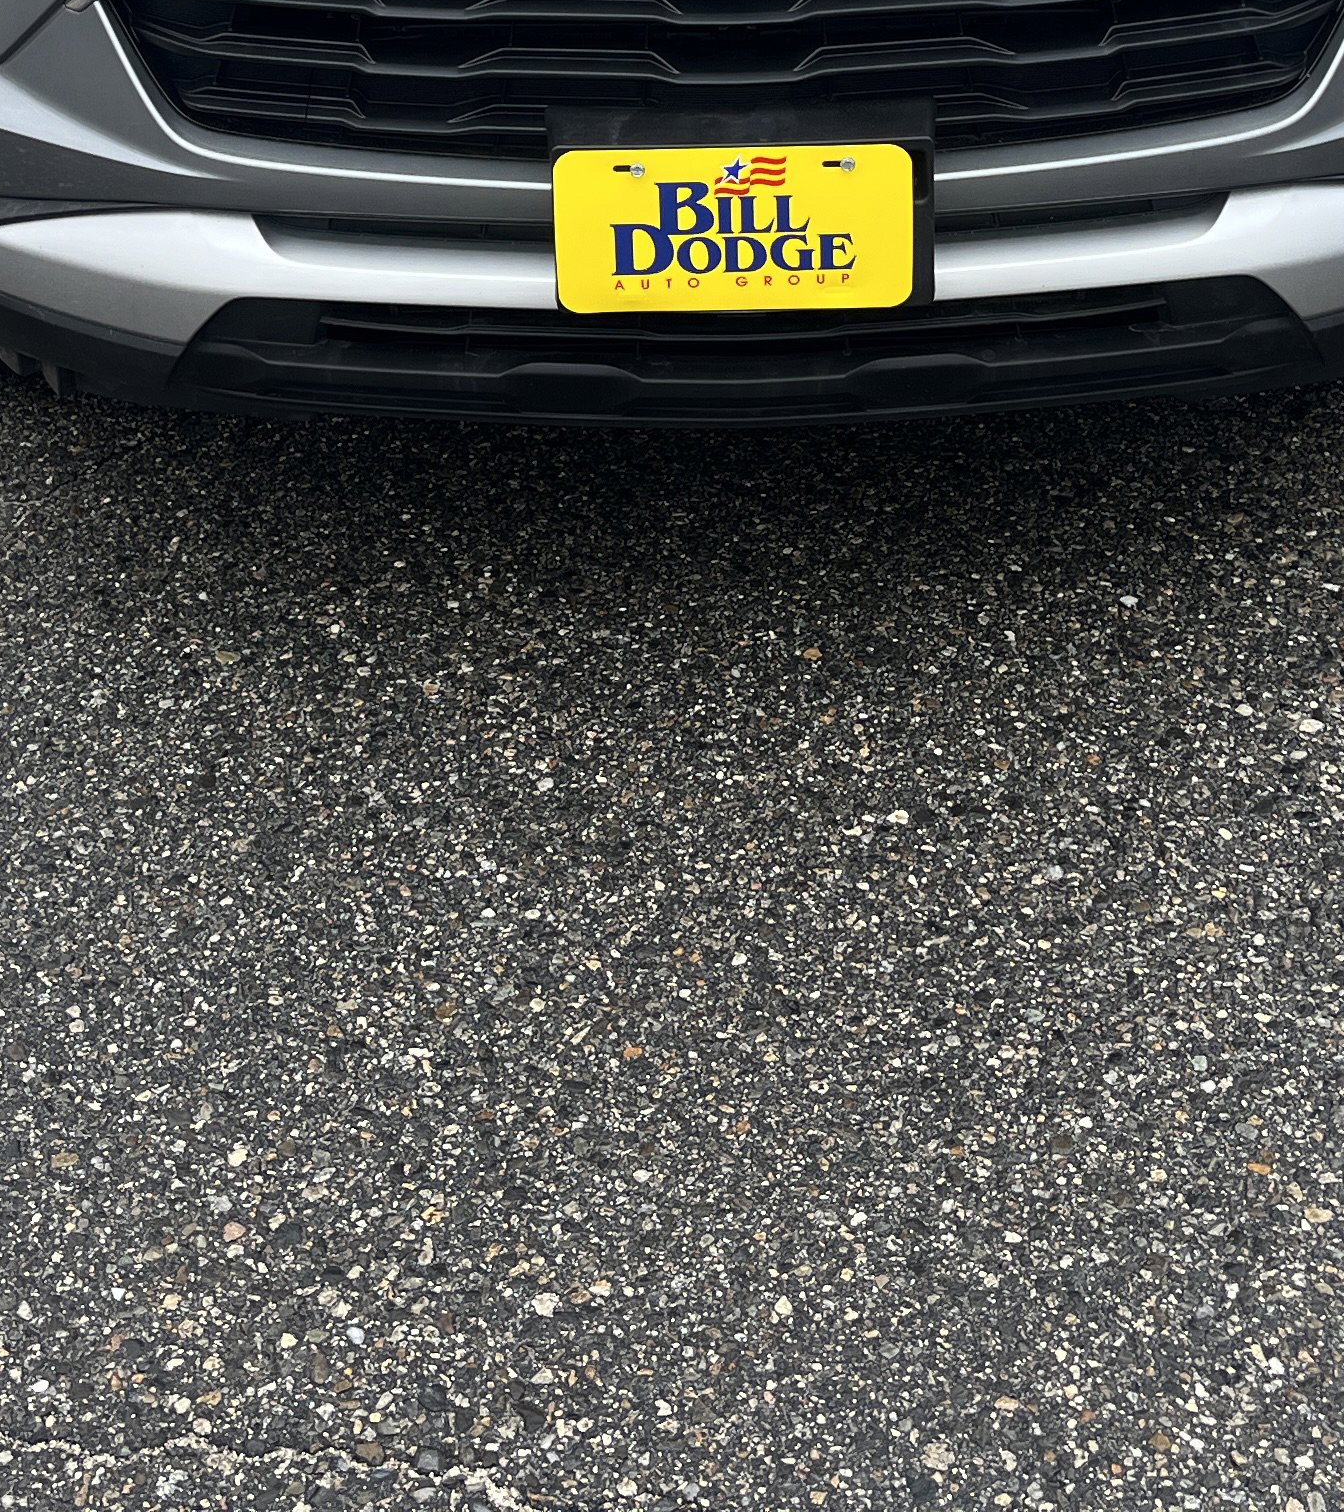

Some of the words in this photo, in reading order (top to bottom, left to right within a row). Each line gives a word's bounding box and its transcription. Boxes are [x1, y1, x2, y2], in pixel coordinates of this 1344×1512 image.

[655, 181, 811, 236] BILL
[610, 223, 856, 276] DODGE
[615, 278, 701, 290] AUTO
[735, 274, 850, 287] GROUP
